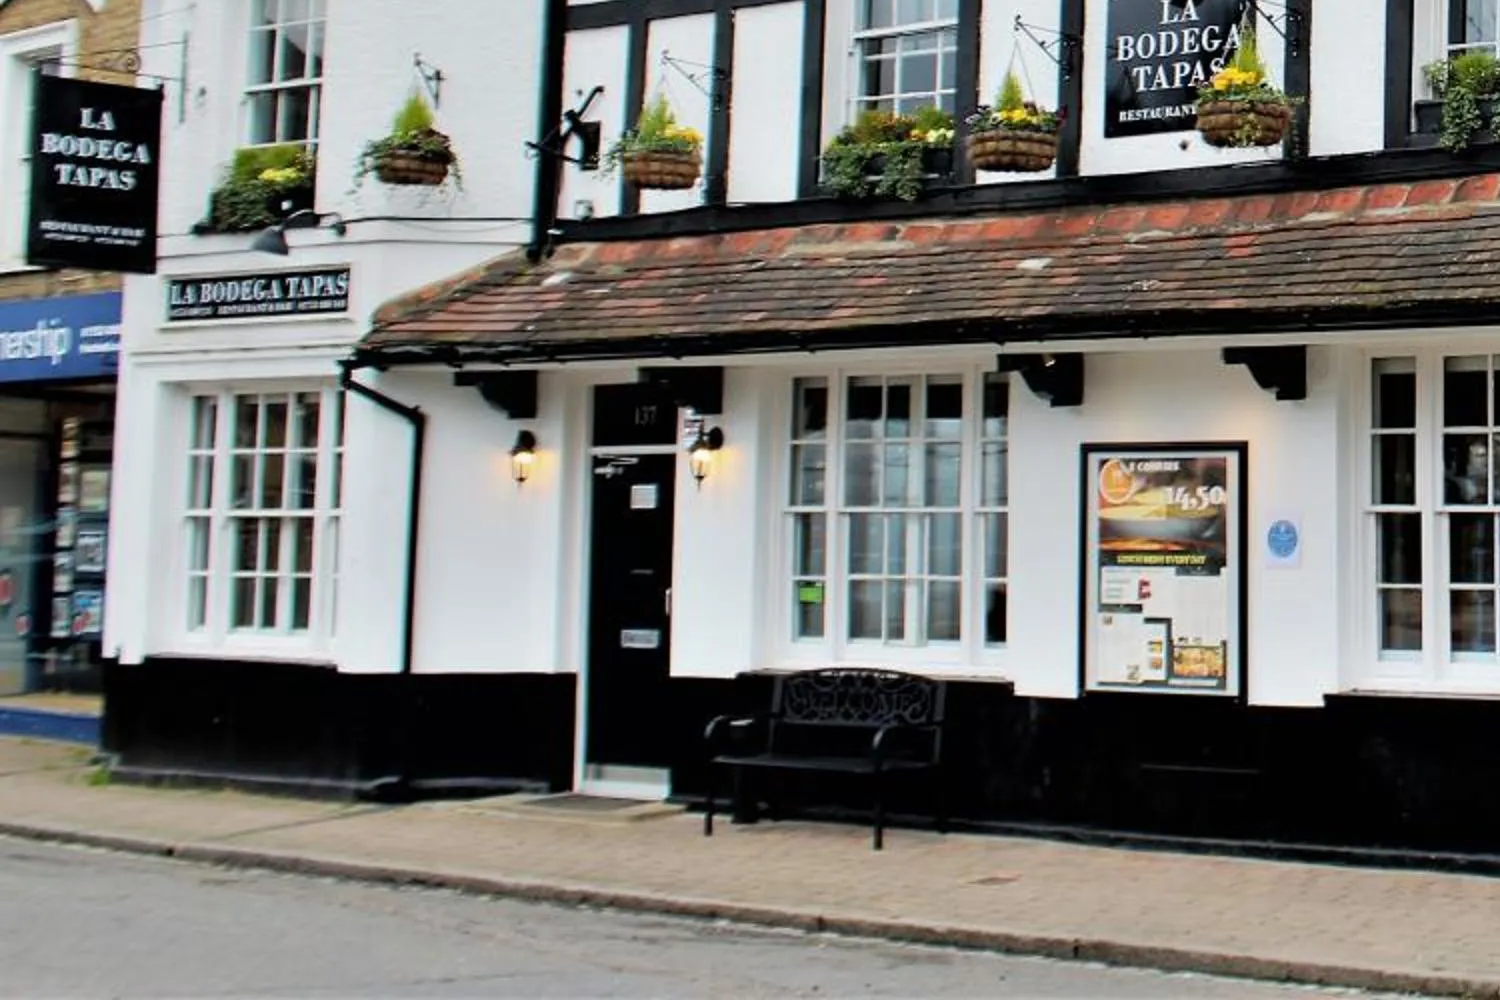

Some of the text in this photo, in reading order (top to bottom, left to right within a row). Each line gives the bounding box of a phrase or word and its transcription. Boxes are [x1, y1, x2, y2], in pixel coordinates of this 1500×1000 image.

[1116, 23, 1240, 62] BODEGA
[1131, 57, 1226, 93] TAPAS
[79, 107, 115, 131] LA
[41, 133, 150, 164] BODEGA
[54, 163, 137, 190] TAPAS
[171, 273, 348, 305] LA BODEGA TAPAS
[635, 405, 657, 425] 137
